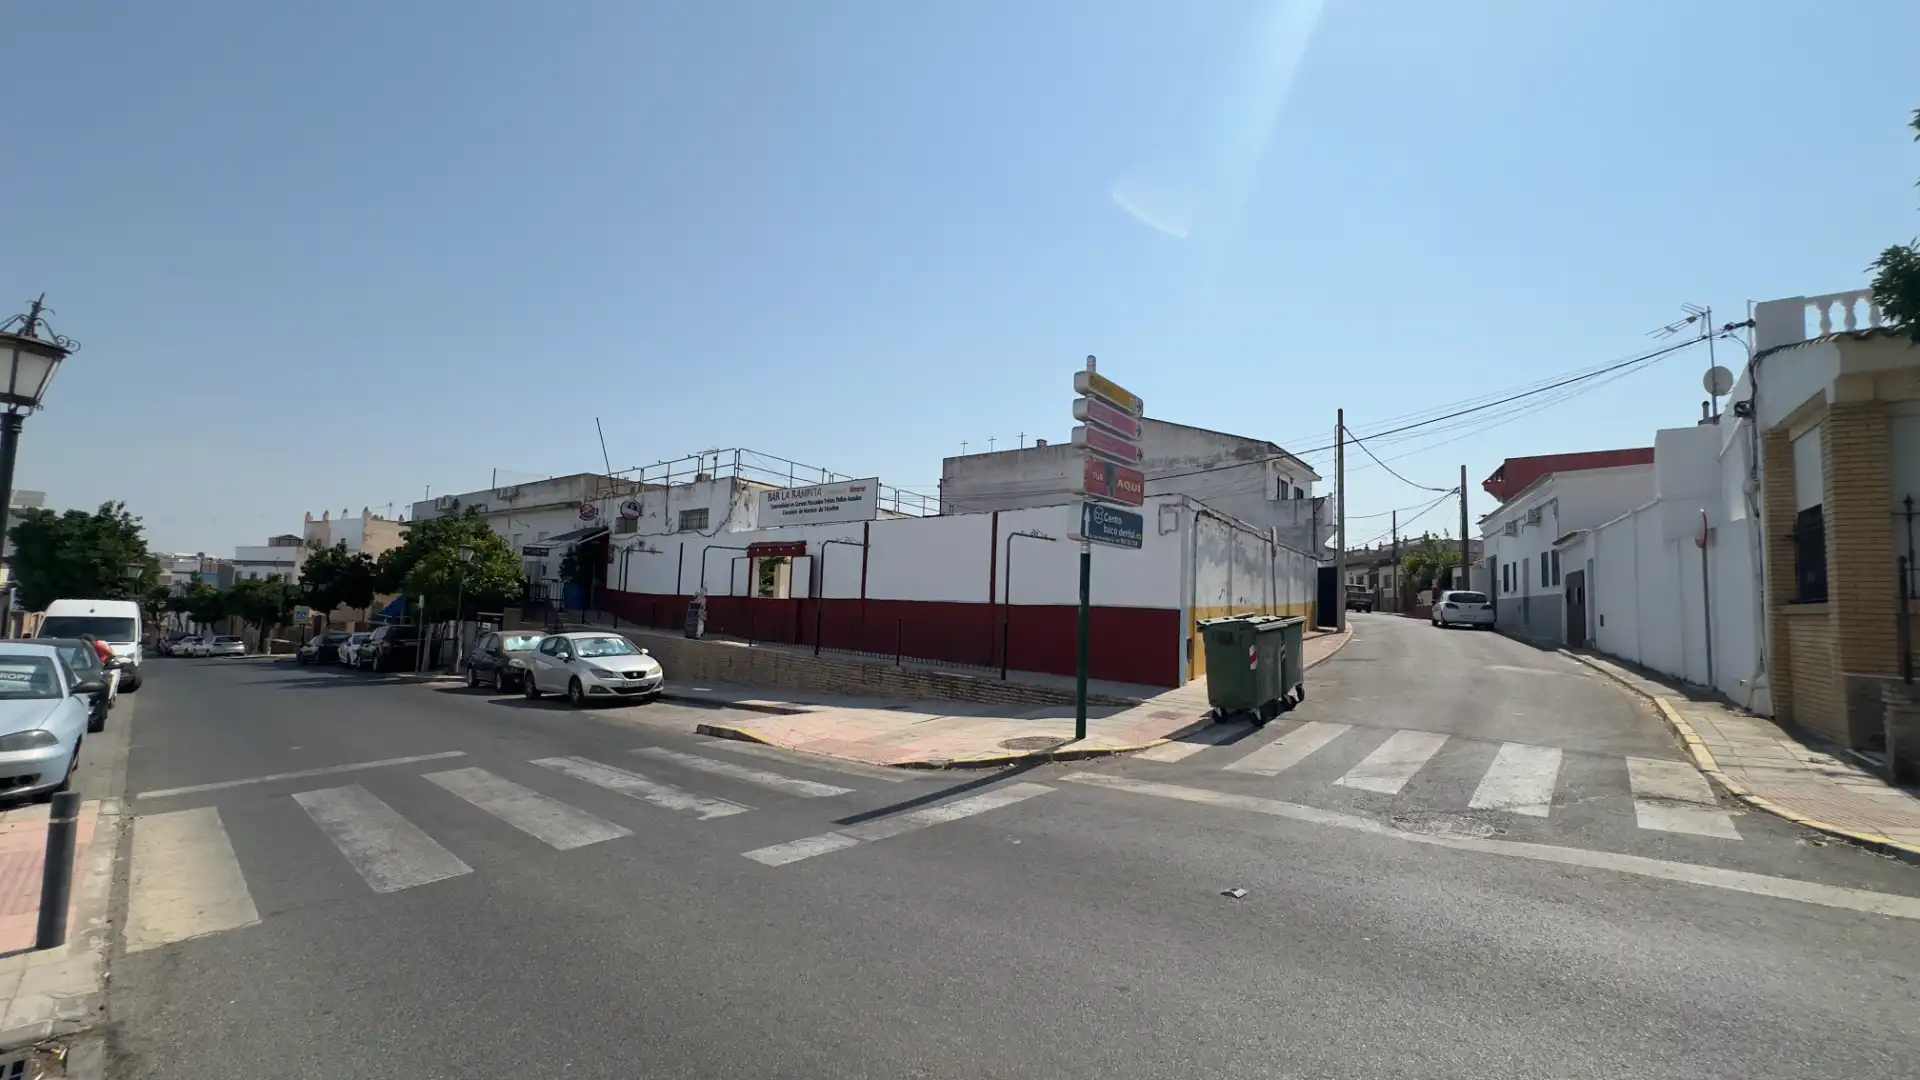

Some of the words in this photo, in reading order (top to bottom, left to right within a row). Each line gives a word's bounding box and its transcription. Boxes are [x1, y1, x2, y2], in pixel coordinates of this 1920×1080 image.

[768, 492, 780, 502] BAR
[782, 491, 790, 500] LA
[791, 488, 822, 499] RAMPITA
[1104, 513, 1122, 525] Centro
[1104, 524, 1117, 535] buco
